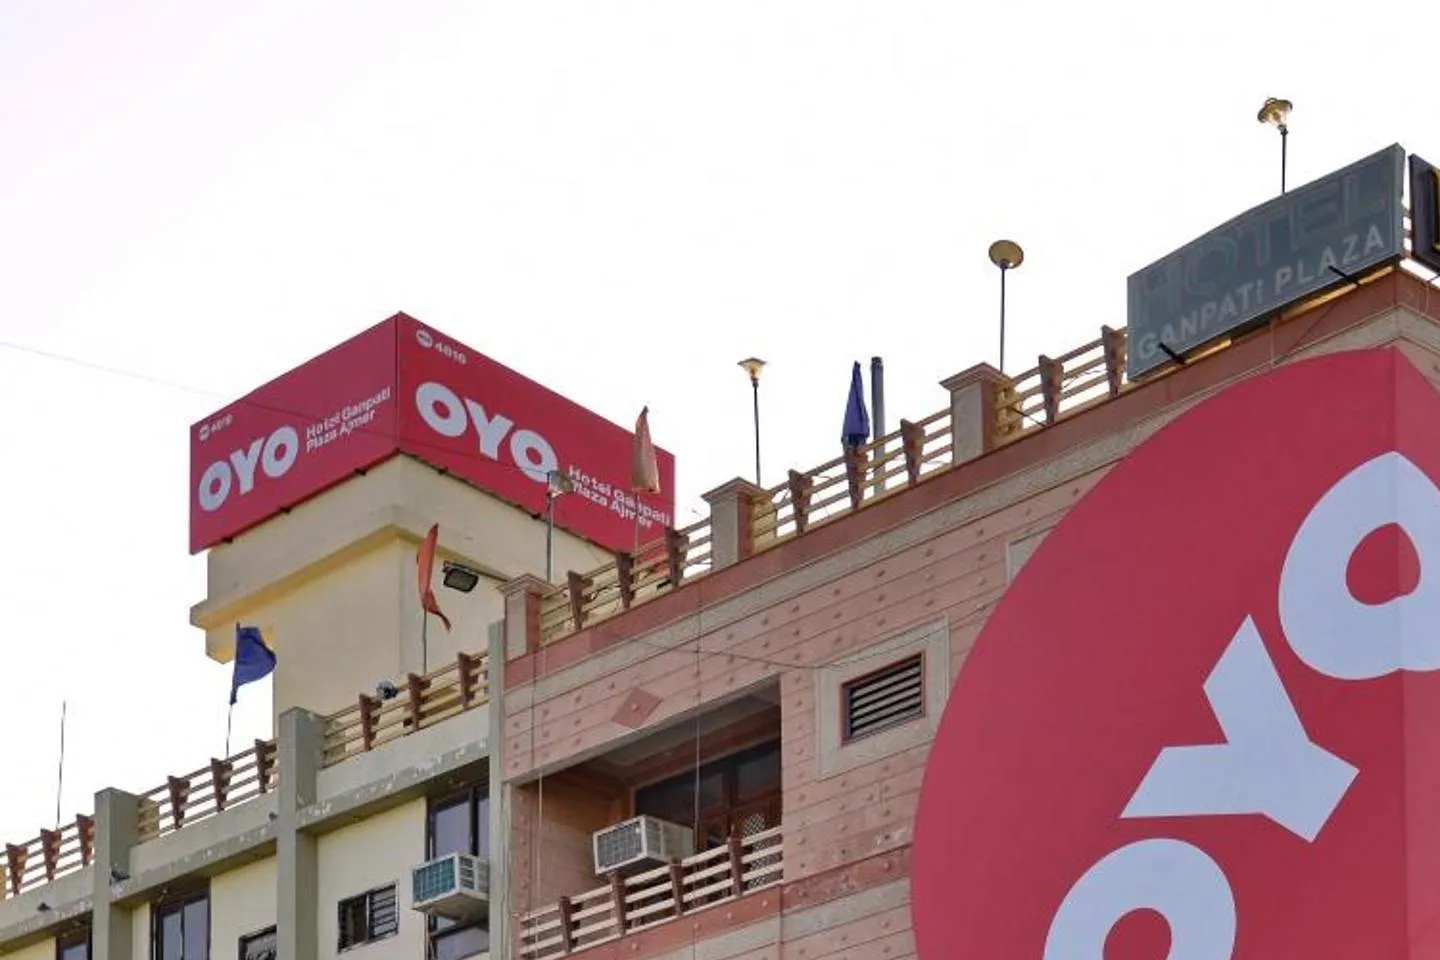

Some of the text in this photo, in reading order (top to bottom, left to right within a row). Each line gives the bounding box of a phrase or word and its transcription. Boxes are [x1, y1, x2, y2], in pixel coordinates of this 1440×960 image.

[1275, 224, 1385, 294] PLAZA
[306, 386, 391, 440] Hotel Ganpati
[306, 409, 376, 453] Plaza Ajmer
[416, 382, 558, 483] OYO
[198, 425, 299, 512] OYO
[568, 464, 612, 497] Hotel
